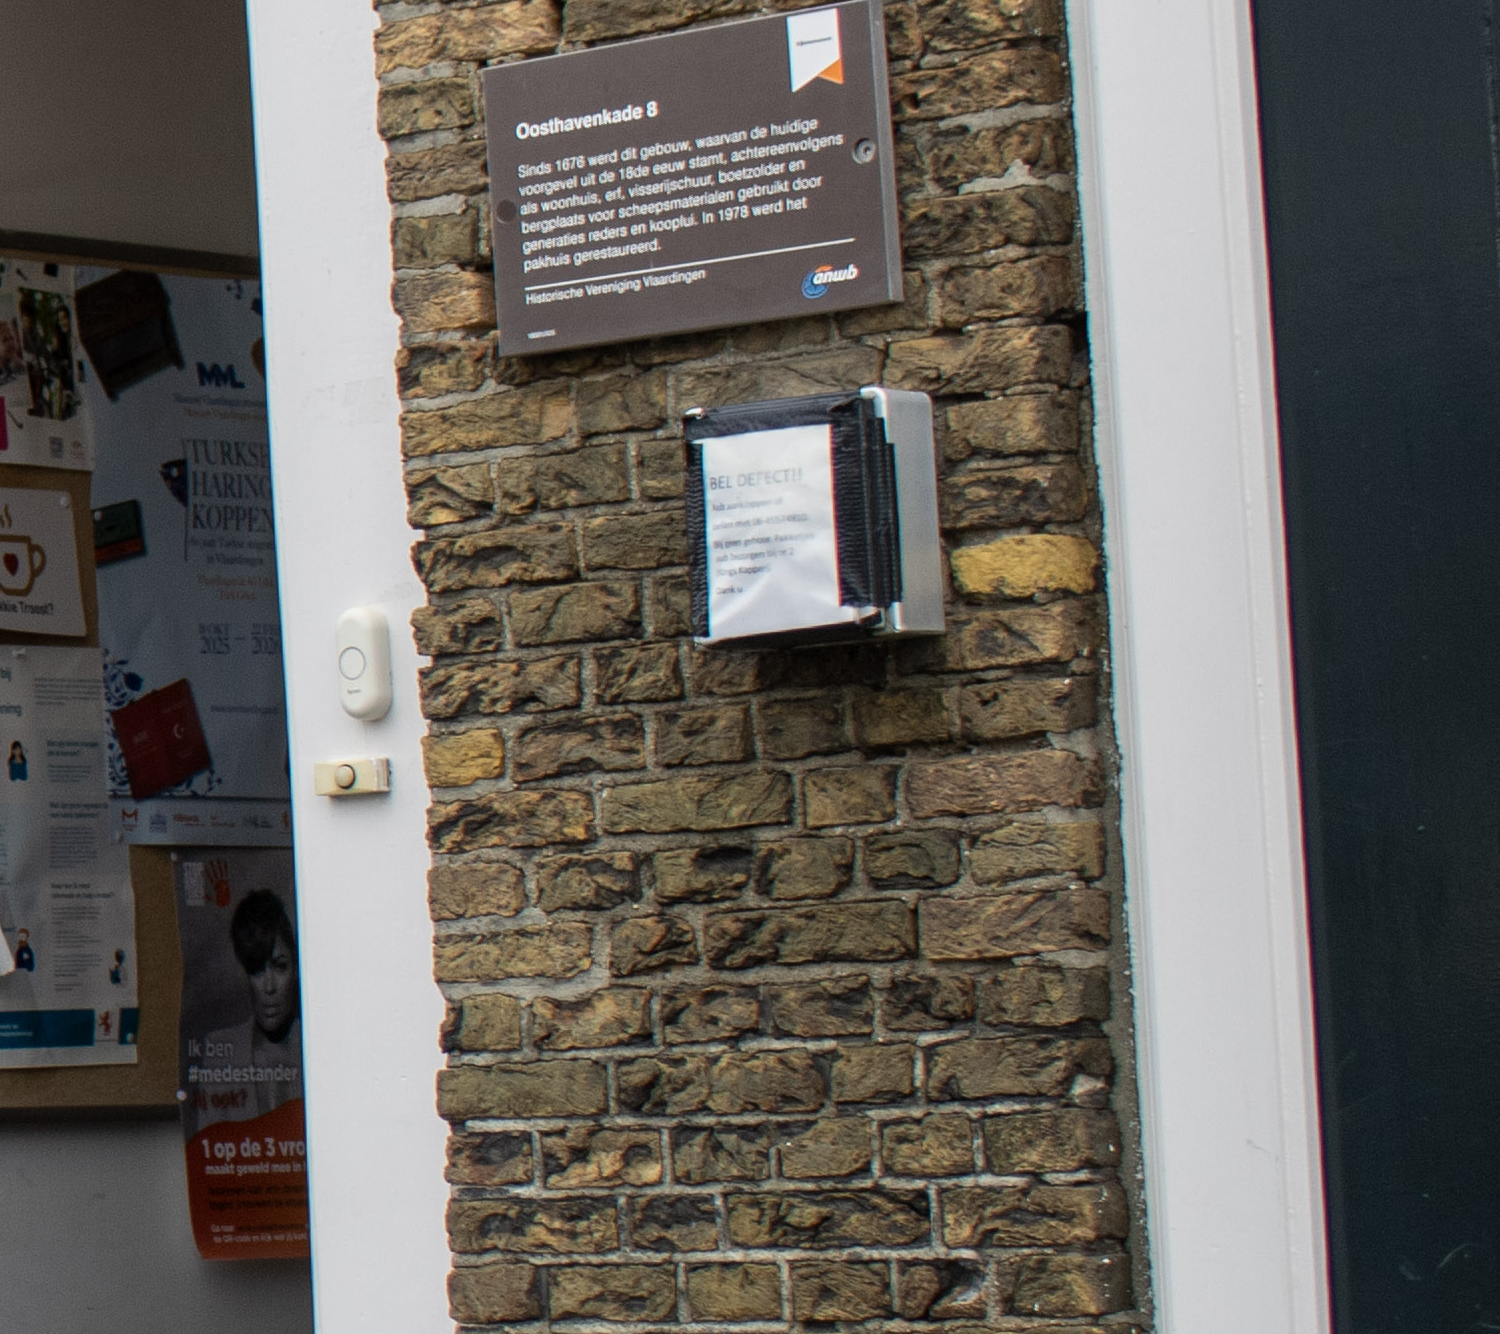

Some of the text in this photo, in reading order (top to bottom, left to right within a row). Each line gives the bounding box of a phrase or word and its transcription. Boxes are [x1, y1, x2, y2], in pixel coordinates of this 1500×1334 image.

[516, 100, 659, 139] Oosthavenkade 8
[518, 161, 552, 178] Sinds
[588, 150, 618, 166] werd
[621, 147, 637, 161] dit
[695, 130, 747, 148] waarvan
[750, 126, 768, 139] de
[770, 119, 819, 136] huidige
[519, 175, 577, 196] voorgevel
[580, 173, 596, 186] uit
[599, 170, 615, 184] de
[619, 165, 649, 180] 18de
[652, 160, 686, 175] eeuw
[730, 134, 844, 164] achtereenvolgens
[520, 202, 538, 215] als
[718, 162, 786, 183] boetzolder
[788, 159, 806, 172] en
[521, 176, 822, 234] bergplaats voor scheepsmaterialen gebruikt door
[523, 233, 586, 255] generaties
[588, 227, 628, 242] reders
[630, 223, 647, 237] en
[702, 211, 715, 224] In
[718, 205, 749, 222] 1978
[752, 200, 784, 216] werd
[786, 197, 807, 211] het
[524, 238, 662, 273] pakhuis gerestaureerd.
[526, 269, 706, 305] Historische Vereniging Vlaardingen
[813, 263, 858, 285] anwb
[710, 475, 733, 491] BEL
[188, 1038, 235, 1058] Ik ben
[188, 1064, 299, 1083] #medestander
[202, 1138, 210, 1158] 1
[214, 1142, 237, 1162] op
[240, 1137, 261, 1158] de
[264, 1137, 276, 1157] 3
